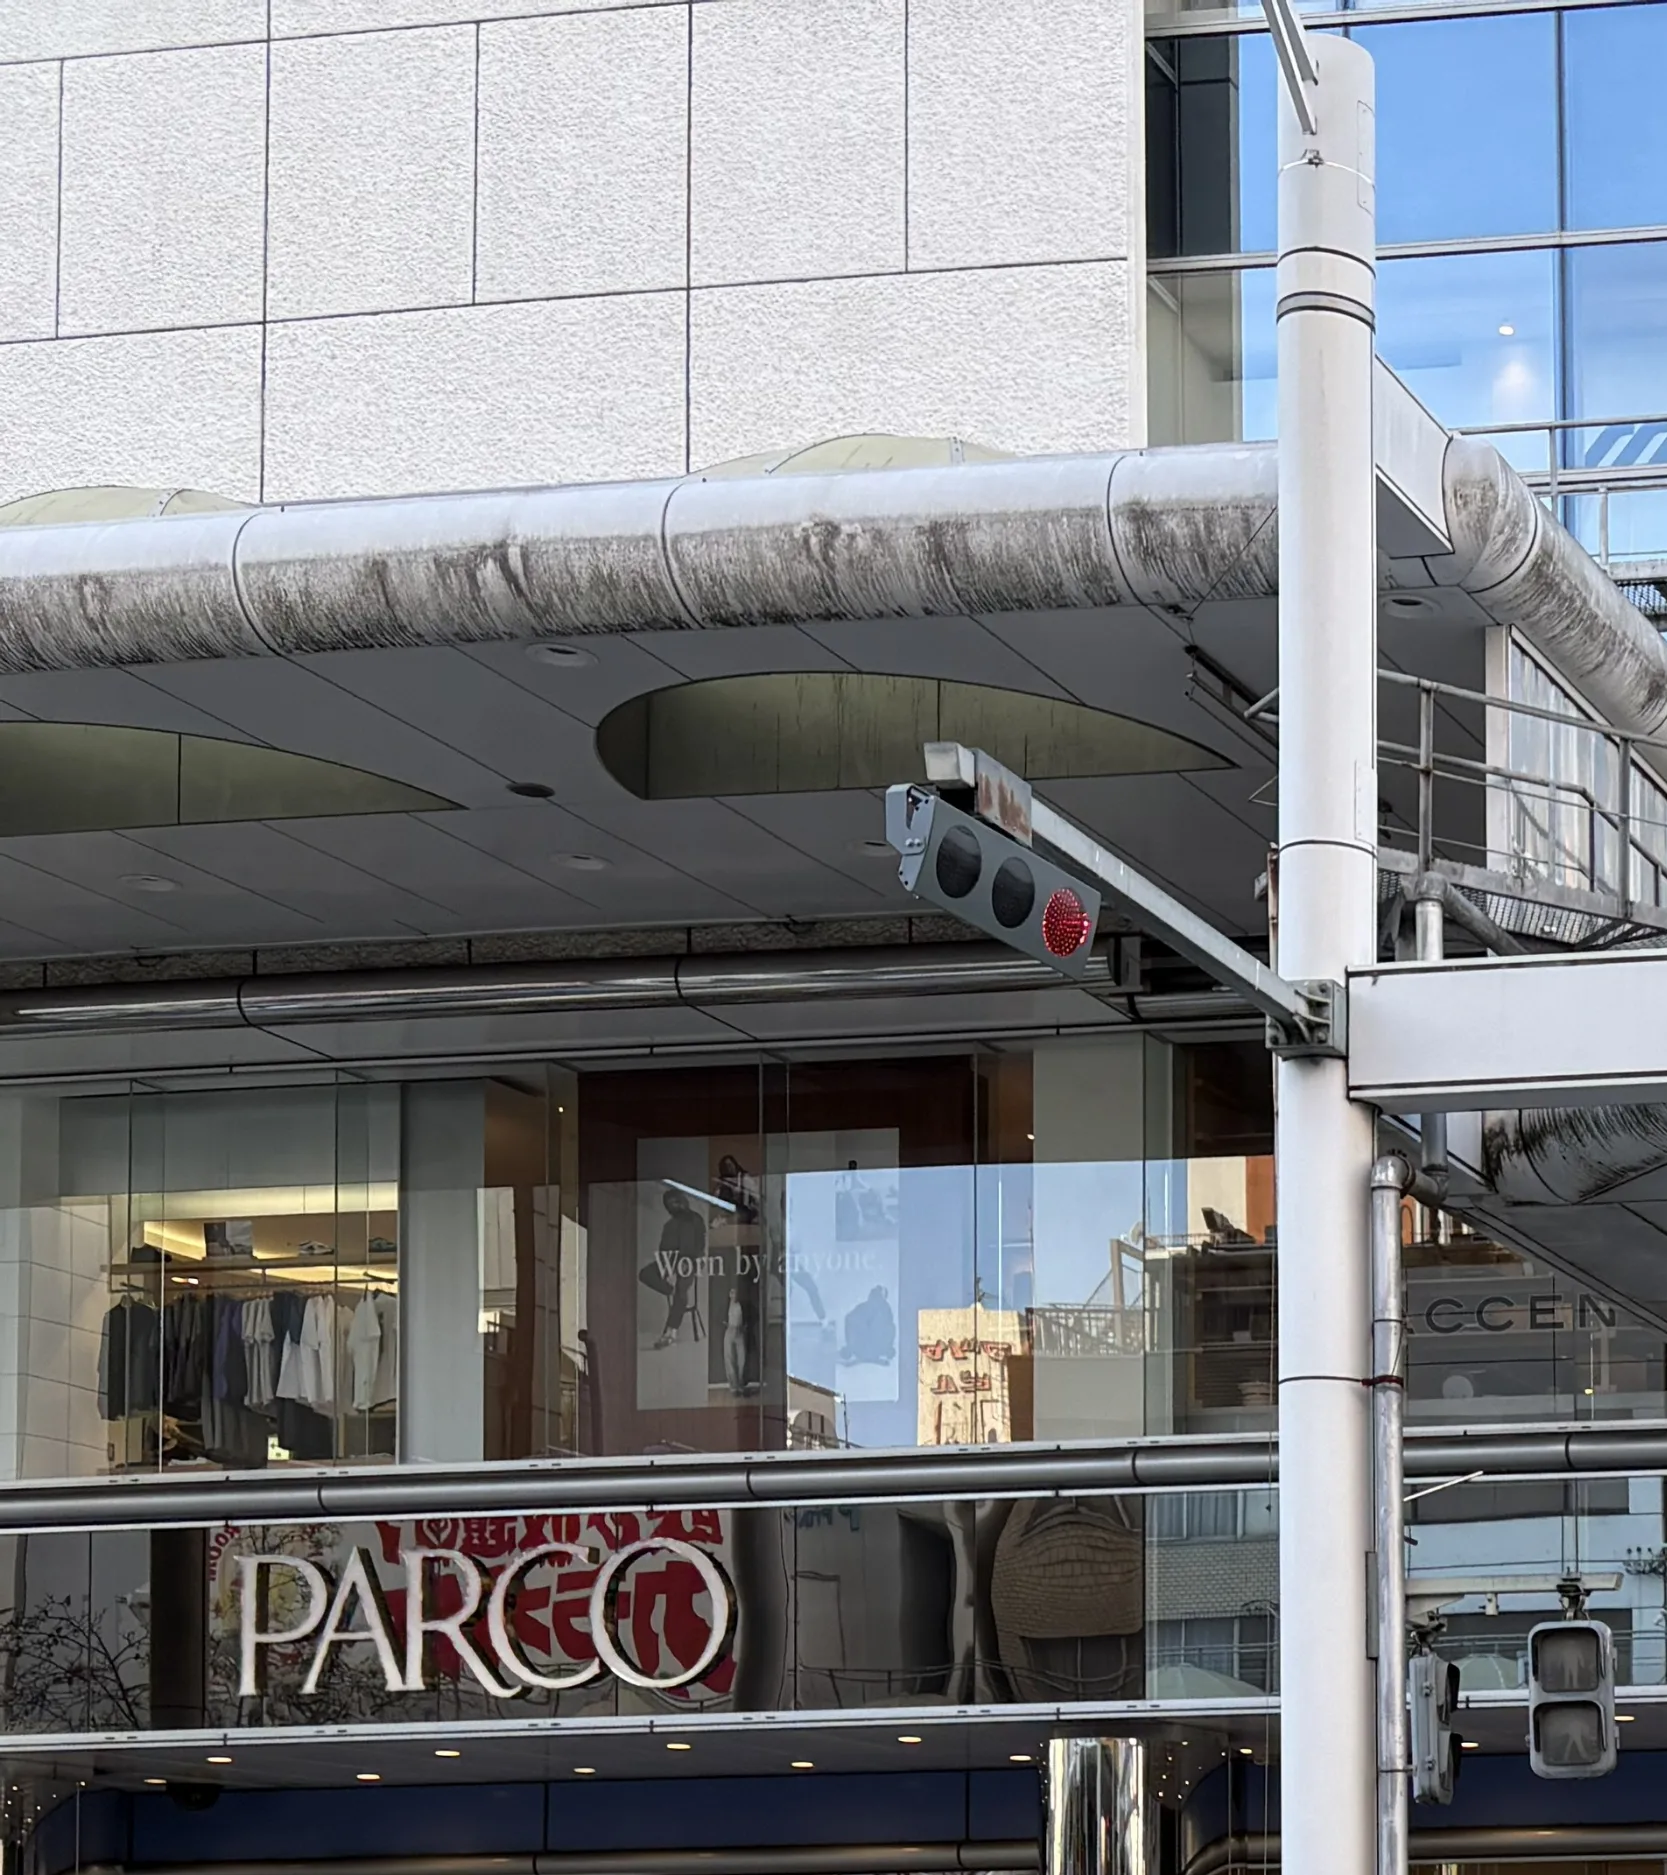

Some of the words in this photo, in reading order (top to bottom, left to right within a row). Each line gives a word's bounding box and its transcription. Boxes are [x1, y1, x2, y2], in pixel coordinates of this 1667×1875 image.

[654, 1250, 726, 1279] Worn
[736, 1246, 767, 1284] by
[1406, 1293, 1617, 1335] CCEN
[233, 1536, 730, 1699] PARCO
